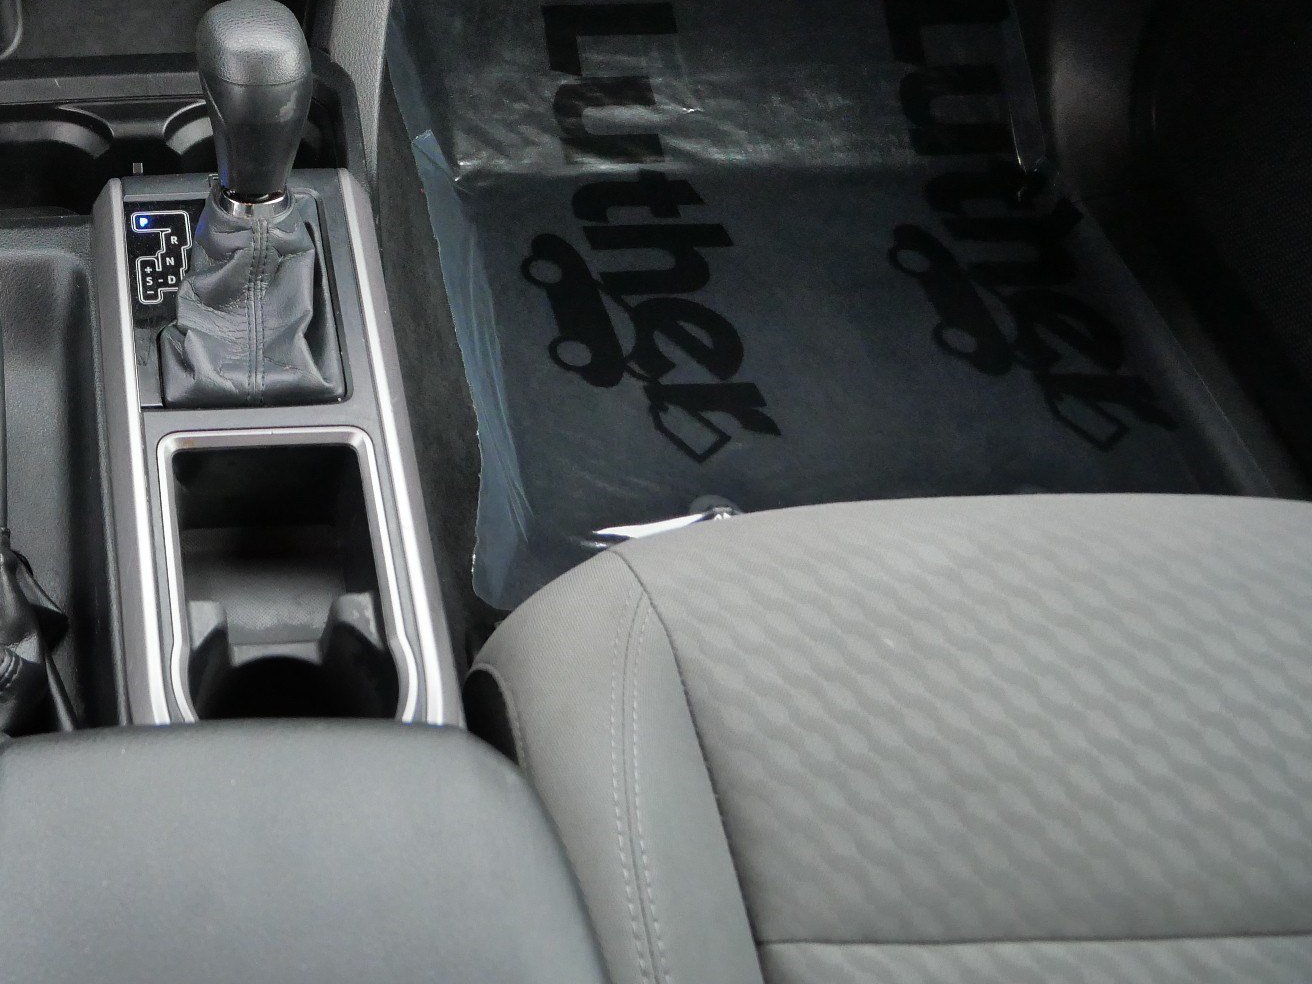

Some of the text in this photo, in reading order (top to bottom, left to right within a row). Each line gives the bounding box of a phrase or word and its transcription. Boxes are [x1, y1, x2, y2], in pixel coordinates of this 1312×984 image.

[541, 2, 780, 435] Luther
[170, 236, 178, 244] R
[166, 257, 175, 265] N
[146, 277, 153, 286] S
[168, 276, 176, 284] D
